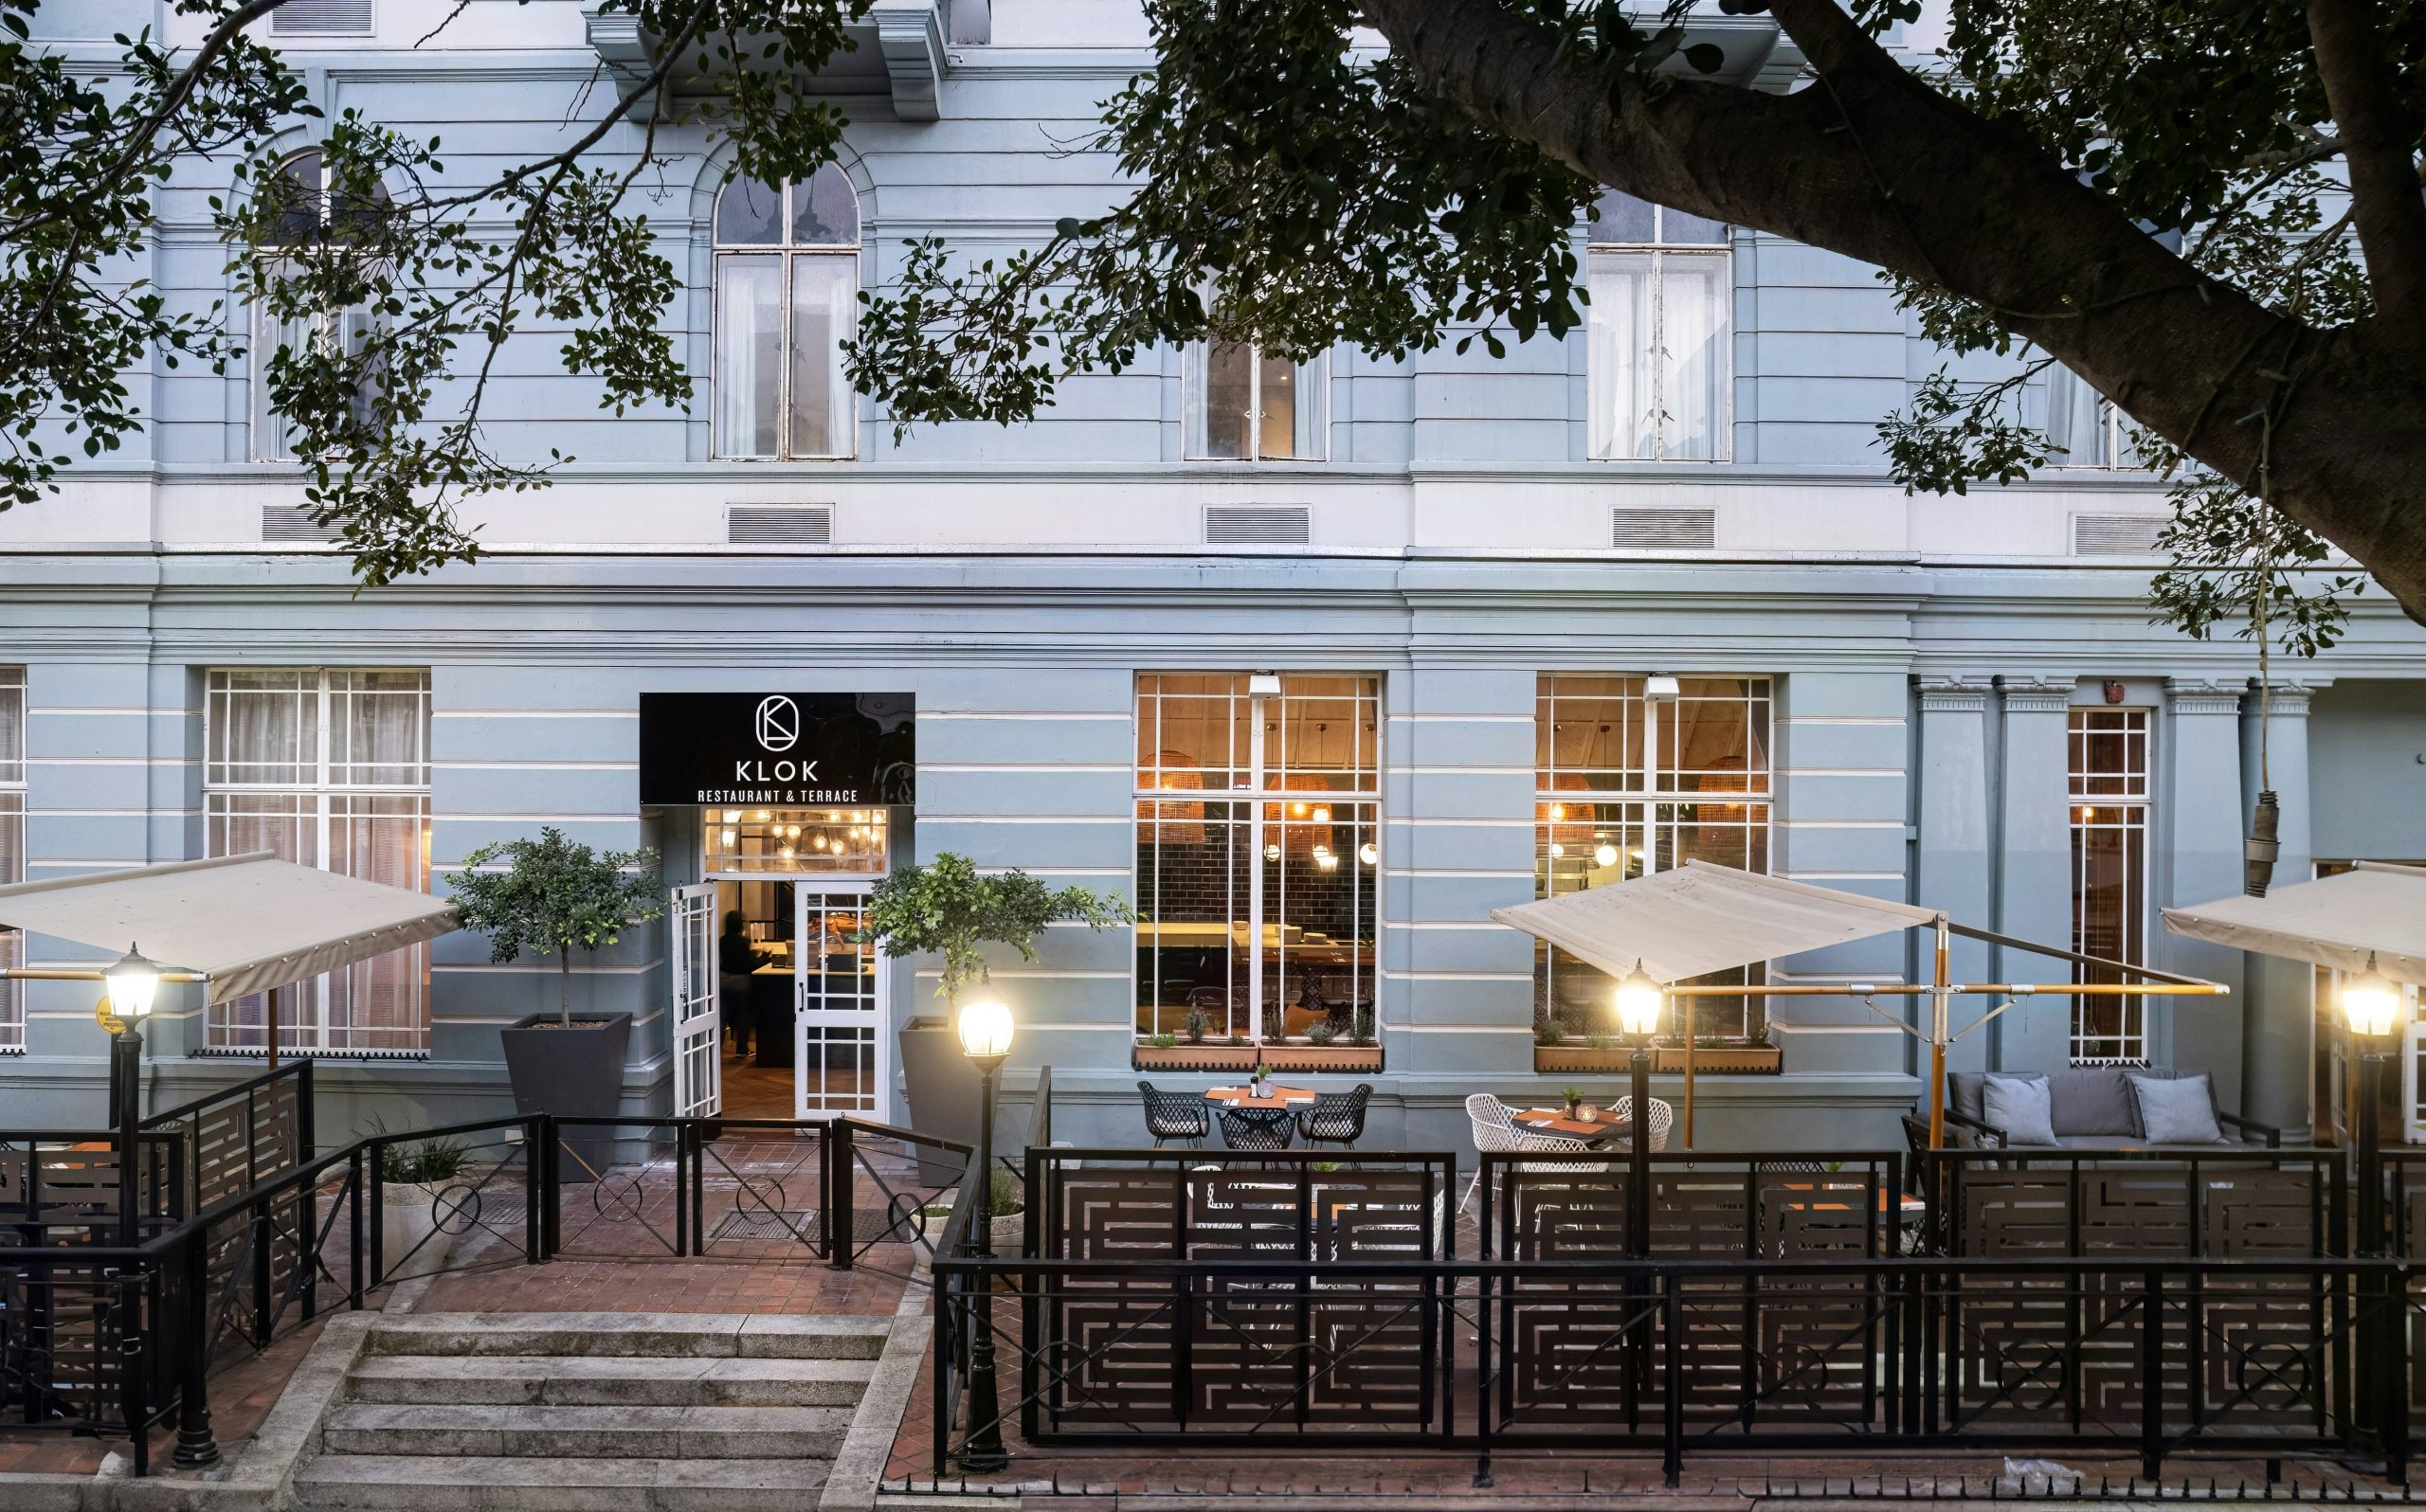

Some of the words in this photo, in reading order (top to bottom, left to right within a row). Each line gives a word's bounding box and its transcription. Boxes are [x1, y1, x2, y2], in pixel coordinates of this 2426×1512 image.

[736, 761, 819, 782] KLOK
[697, 789, 780, 802] RESTAURANT
[786, 789, 795, 802] &
[801, 789, 858, 802] TERRACE
